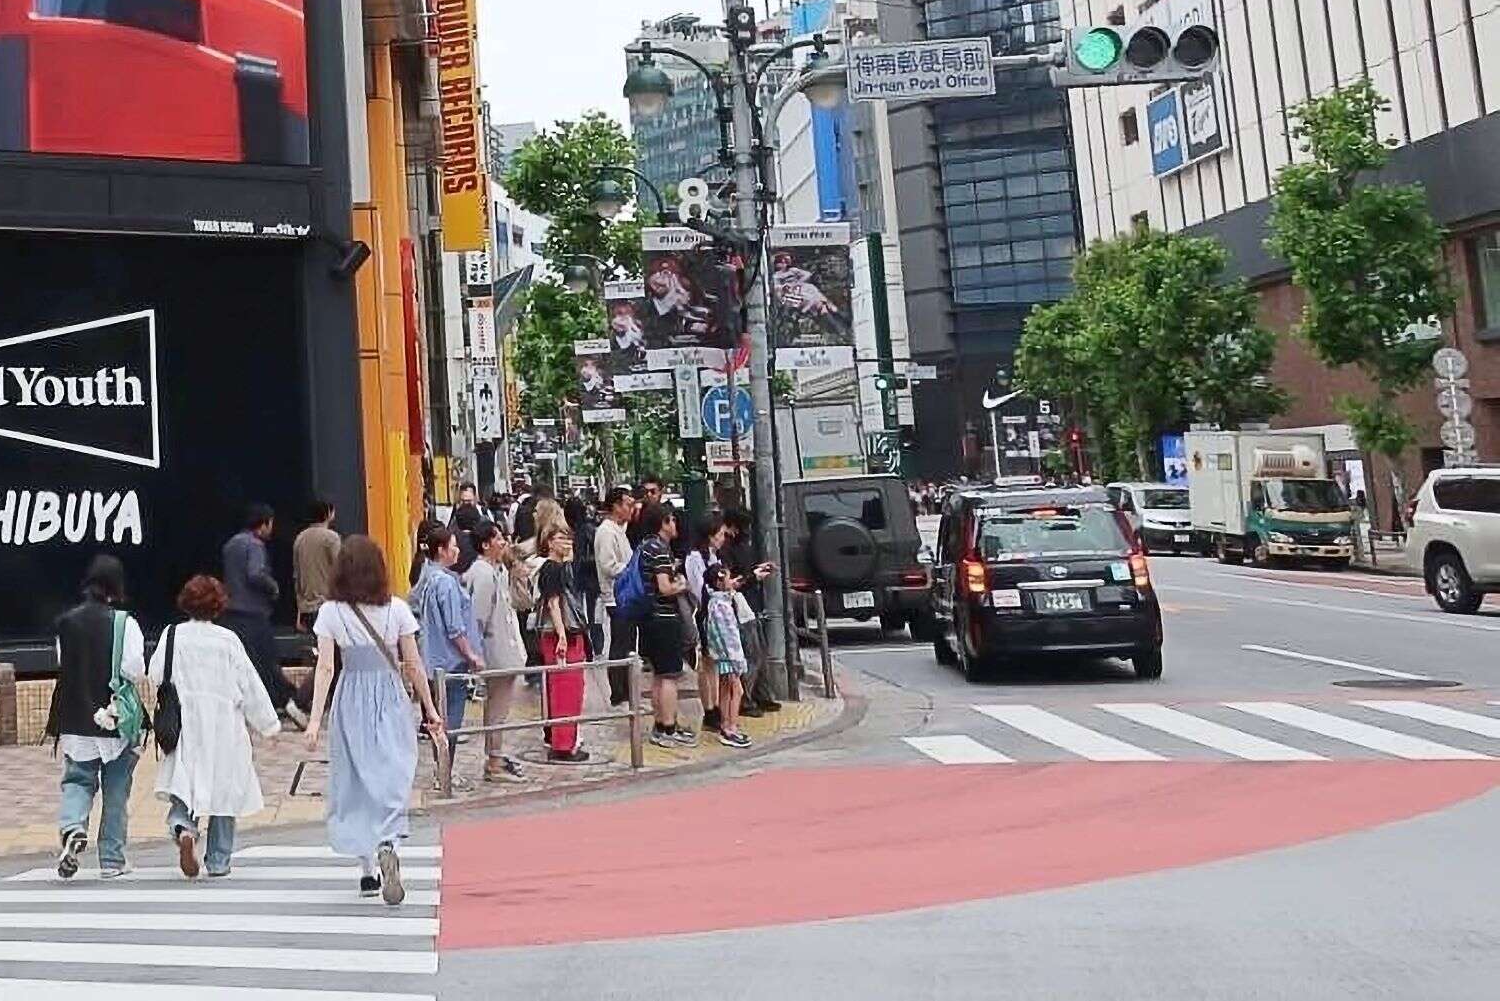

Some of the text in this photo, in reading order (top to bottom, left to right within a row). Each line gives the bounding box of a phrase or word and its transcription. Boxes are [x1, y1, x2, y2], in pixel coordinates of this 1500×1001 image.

[856, 48, 984, 77] 神南郵便局前
[855, 73, 988, 94] Jin-nan Post Office
[441, 77, 478, 195] RECORDS
